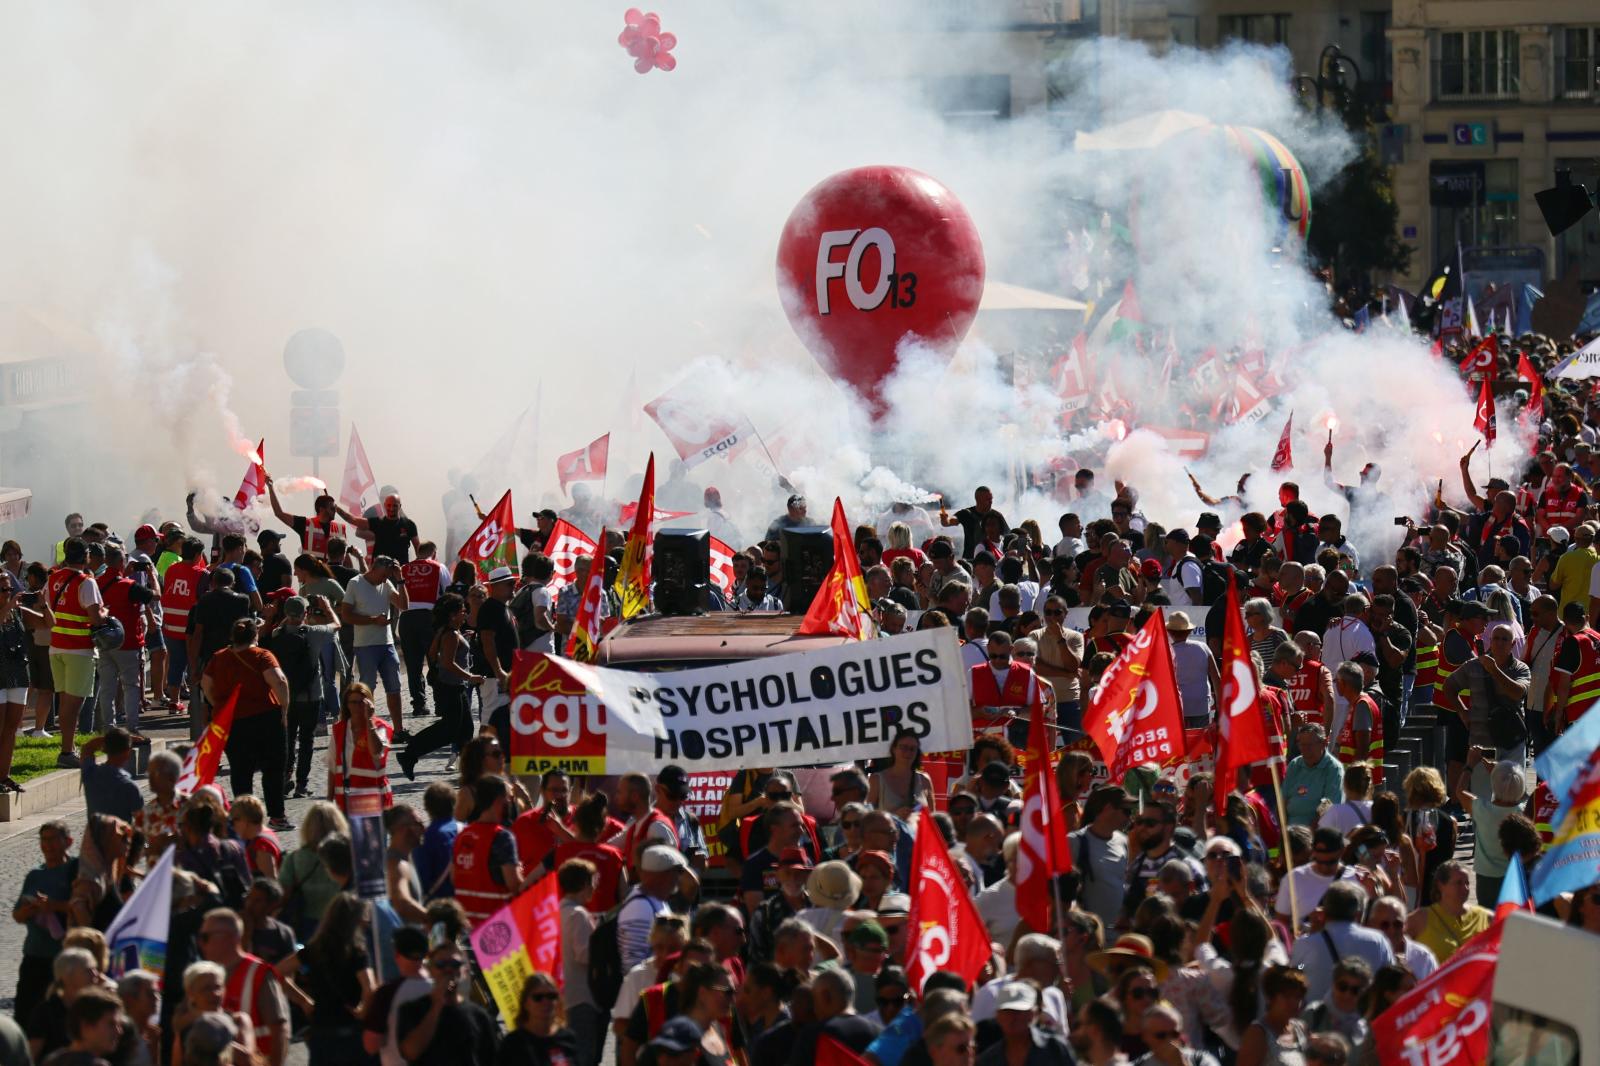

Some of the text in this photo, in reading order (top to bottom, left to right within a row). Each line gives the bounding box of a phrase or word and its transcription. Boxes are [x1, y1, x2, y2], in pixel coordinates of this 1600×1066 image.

[816, 227, 917, 316] FO 13
[476, 520, 499, 558] FO
[654, 701, 931, 760] HOSPITALIERS
[456, 853, 474, 870] cgt
